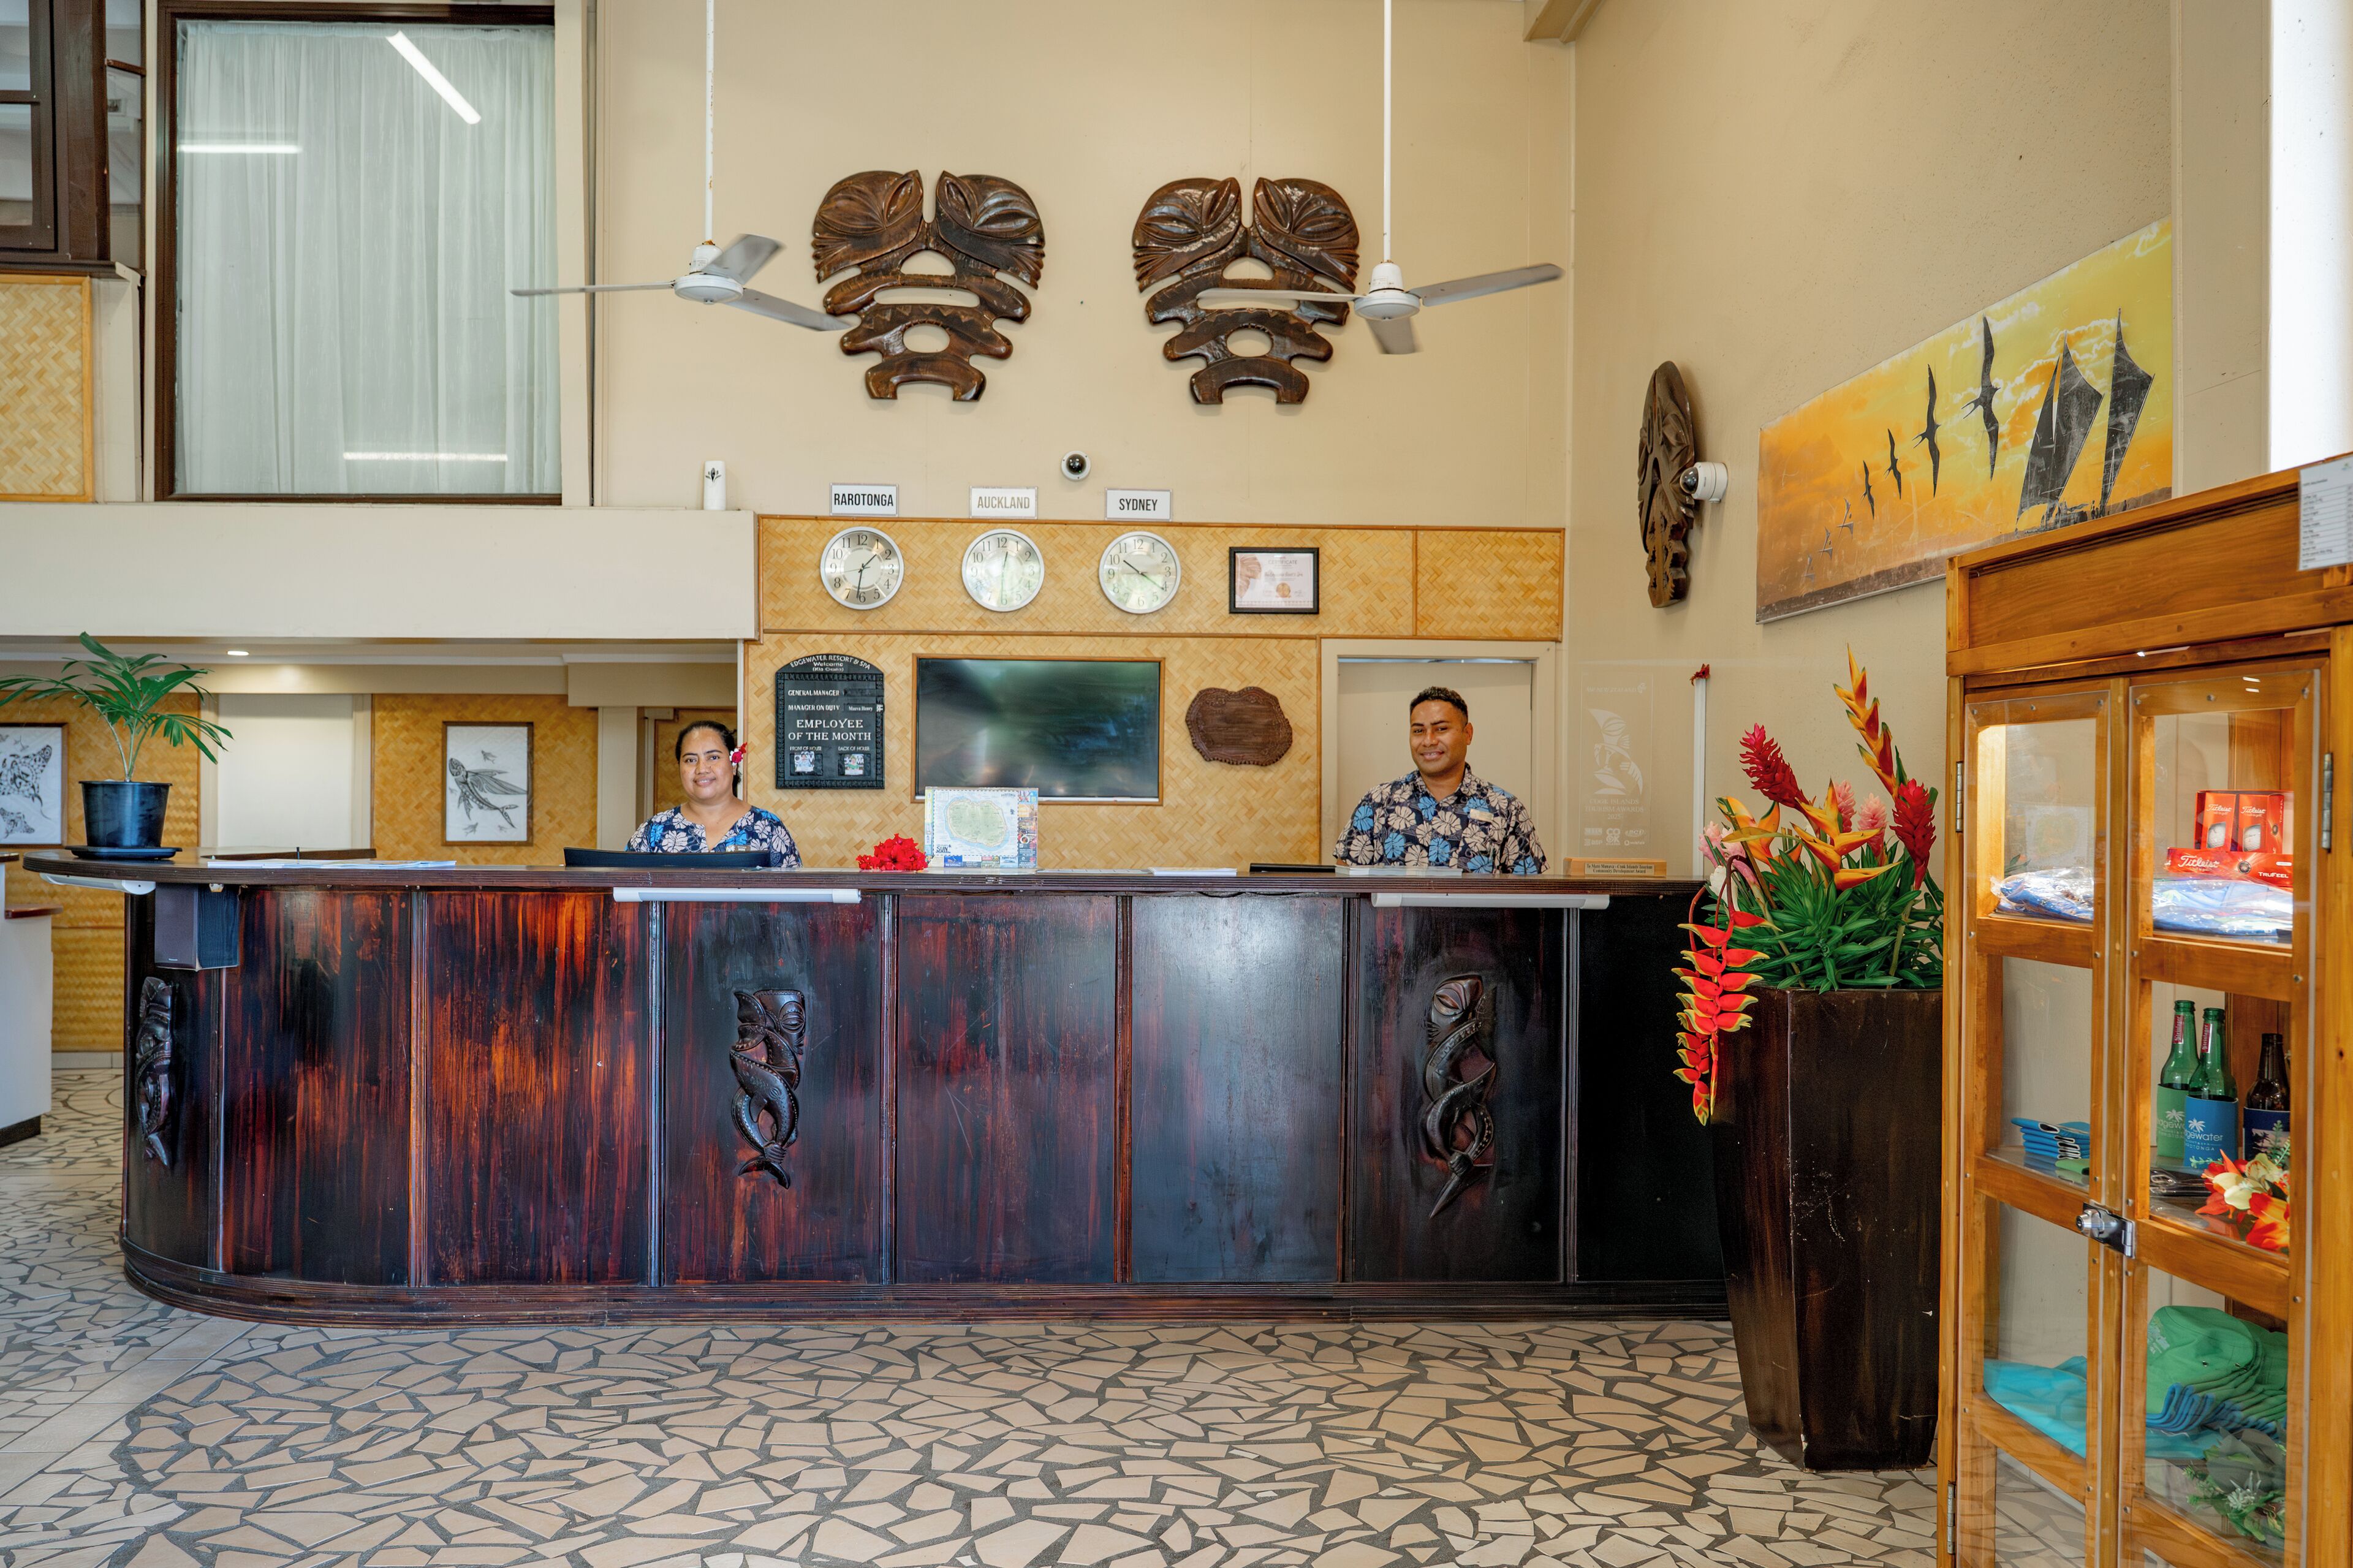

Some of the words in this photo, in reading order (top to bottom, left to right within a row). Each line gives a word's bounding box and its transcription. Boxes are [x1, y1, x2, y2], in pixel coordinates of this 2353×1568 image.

[834, 493, 893, 506] RAROTONGA
[977, 496, 1029, 509] AUCKLAND
[1119, 498, 1158, 511] SYDNEY
[843, 537, 851, 548] 11
[857, 534, 868, 545] 12
[876, 539, 879, 549] 1
[997, 537, 1007, 548] 12
[1134, 539, 1143, 550] 12
[982, 541, 991, 551] 11
[1015, 541, 1018, 551] 1
[1119, 543, 1127, 553] 11
[1152, 542, 1155, 553] 1
[832, 548, 843, 559] 10
[885, 550, 892, 560] 2
[973, 552, 983, 562] 10
[1025, 551, 1031, 562] 2
[1161, 553, 1167, 563] 2
[1109, 554, 1120, 565] 10
[830, 563, 837, 574] 9
[888, 564, 894, 575] 3
[971, 567, 977, 577] 9
[1029, 566, 1035, 576] 3
[1108, 569, 1115, 579] 9
[1165, 567, 1171, 577] 3
[834, 578, 841, 588] 8
[884, 578, 891, 589] 4
[1025, 580, 1032, 590] 4
[1113, 583, 1120, 594] 8
[1164, 581, 1169, 592] 4
[845, 588, 851, 599] 7
[858, 593, 866, 603] 6
[873, 589, 880, 599] 5
[1015, 591, 1022, 601] 5
[1152, 592, 1158, 602] 5
[1001, 594, 1007, 605] 6
[1138, 596, 1145, 607] 6
[790, 654, 827, 668] EDGEWATER
[859, 661, 870, 670] SPA
[797, 718, 863, 728] EMPLOYEE
[2178, 855, 2220, 868] Titleist
